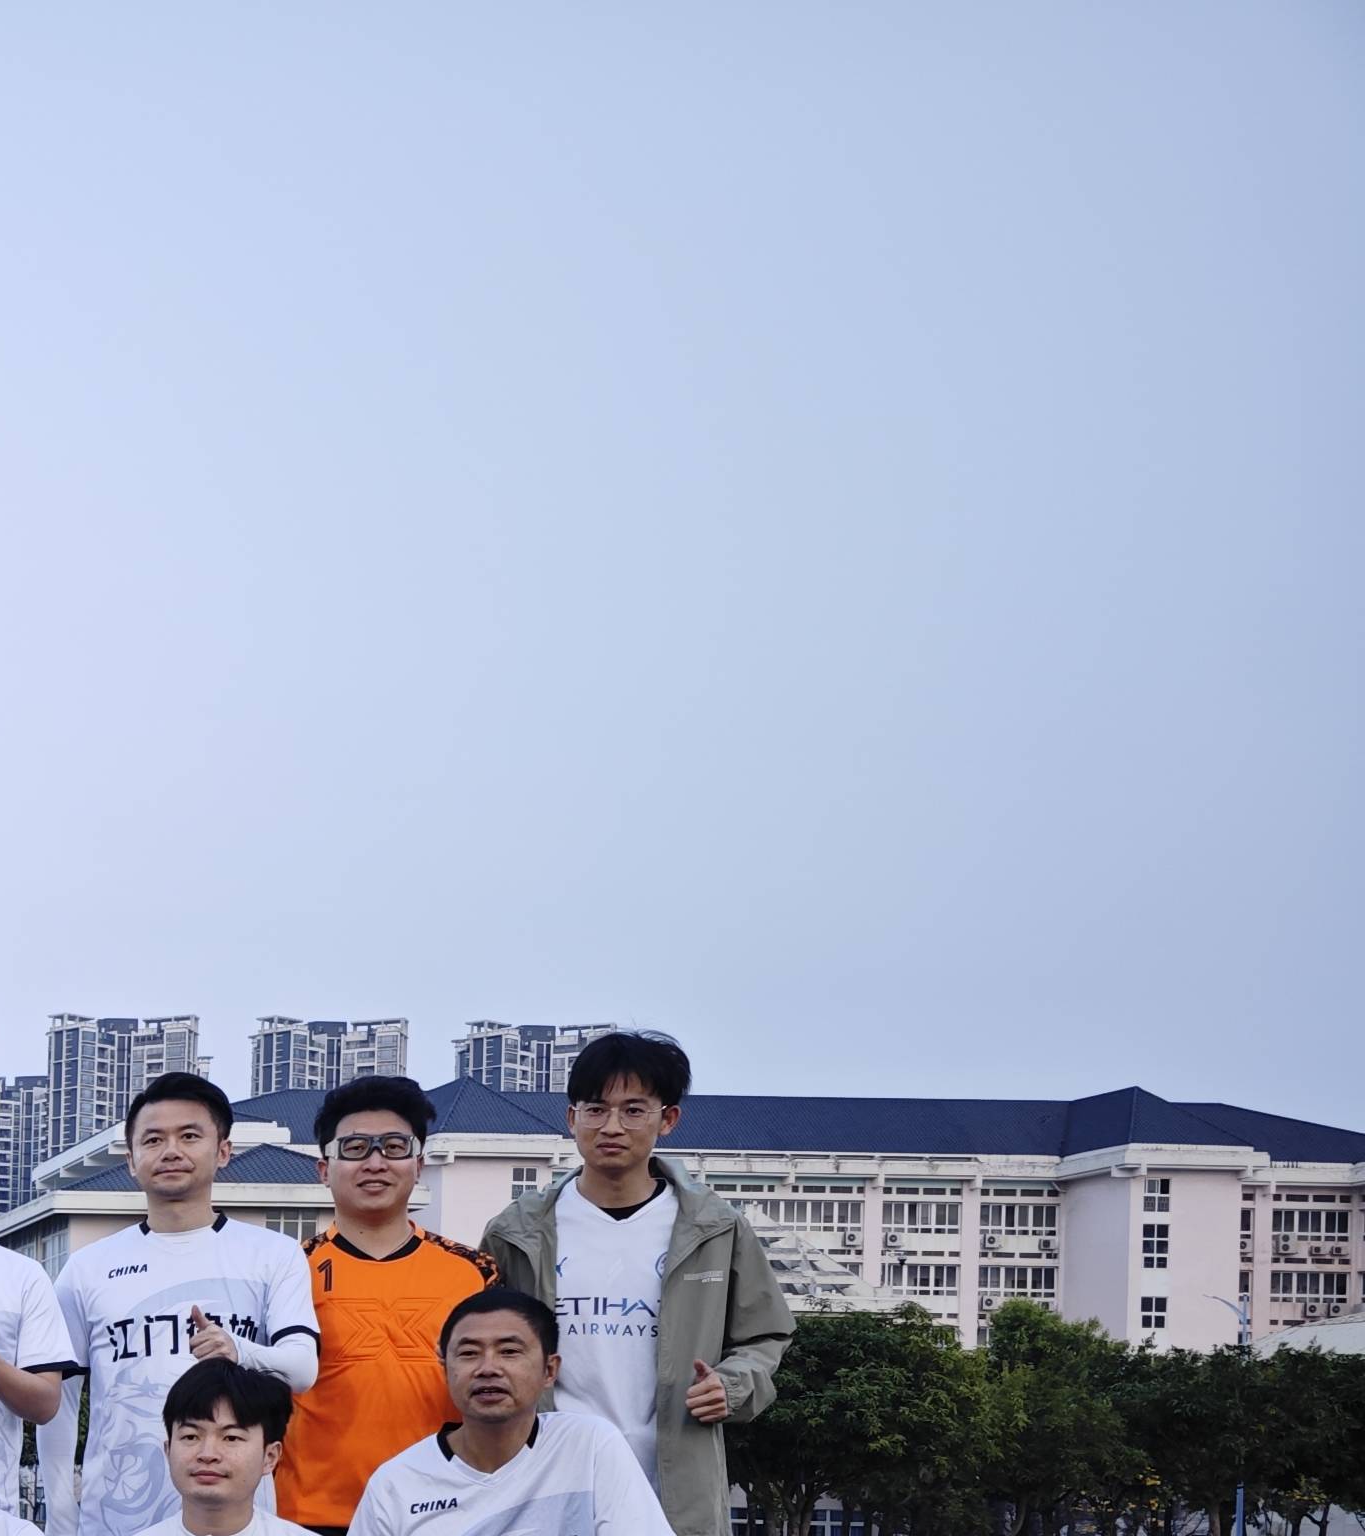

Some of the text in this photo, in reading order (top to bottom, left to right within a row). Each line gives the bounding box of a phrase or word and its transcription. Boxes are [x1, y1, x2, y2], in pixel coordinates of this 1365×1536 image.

[108, 1264, 148, 1279] CHINA
[317, 1258, 332, 1292] 1
[555, 1296, 661, 1318] ETIHA
[567, 1322, 660, 1338] AIRWAYS
[410, 1497, 459, 1515] CHINA
